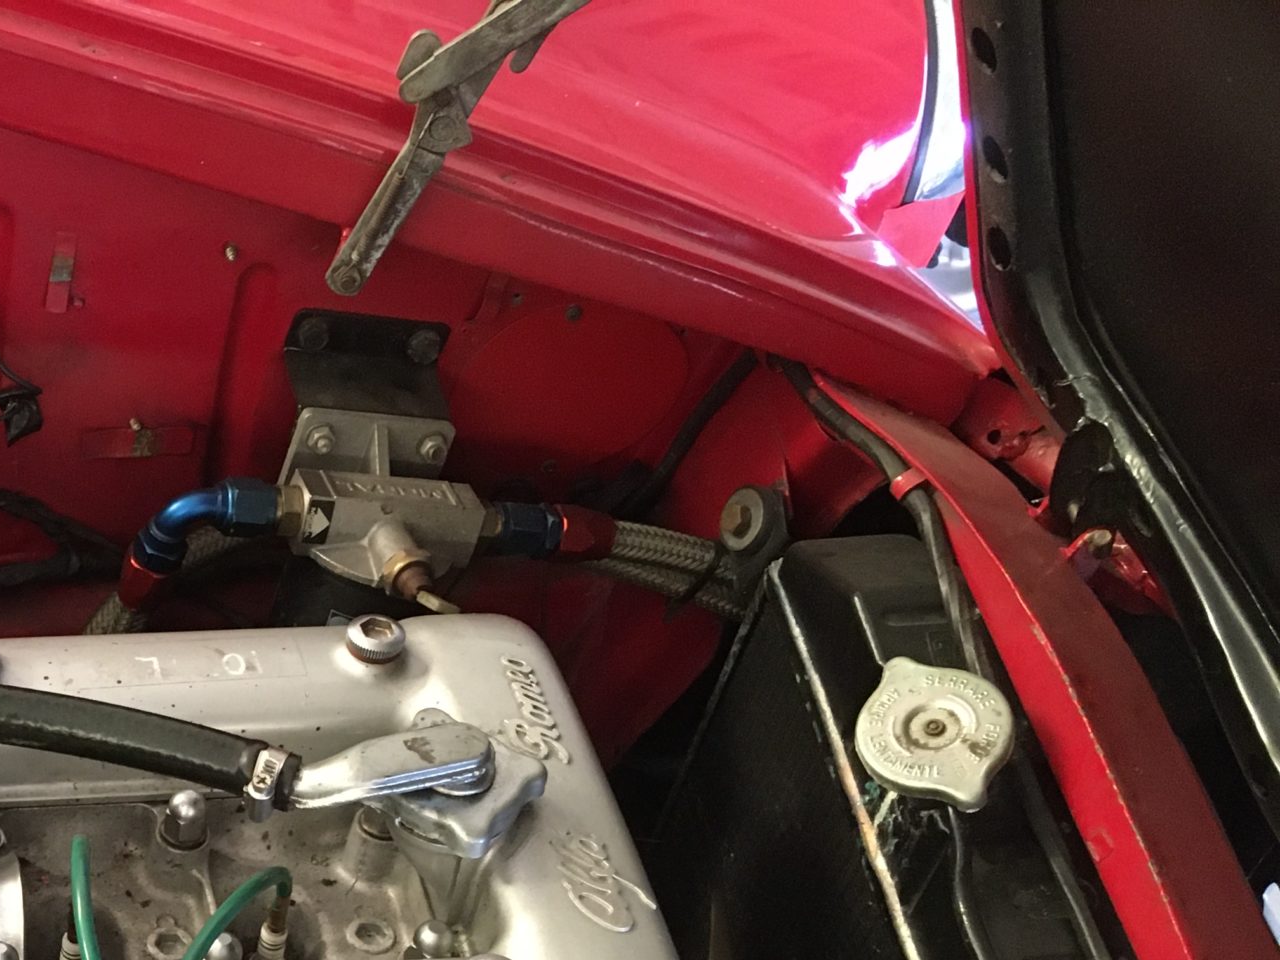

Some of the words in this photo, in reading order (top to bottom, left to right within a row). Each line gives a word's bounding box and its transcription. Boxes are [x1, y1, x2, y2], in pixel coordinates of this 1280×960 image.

[500, 655, 571, 765] Romeo
[924, 674, 996, 710] SERRARE
[548, 832, 657, 933] Alfa
